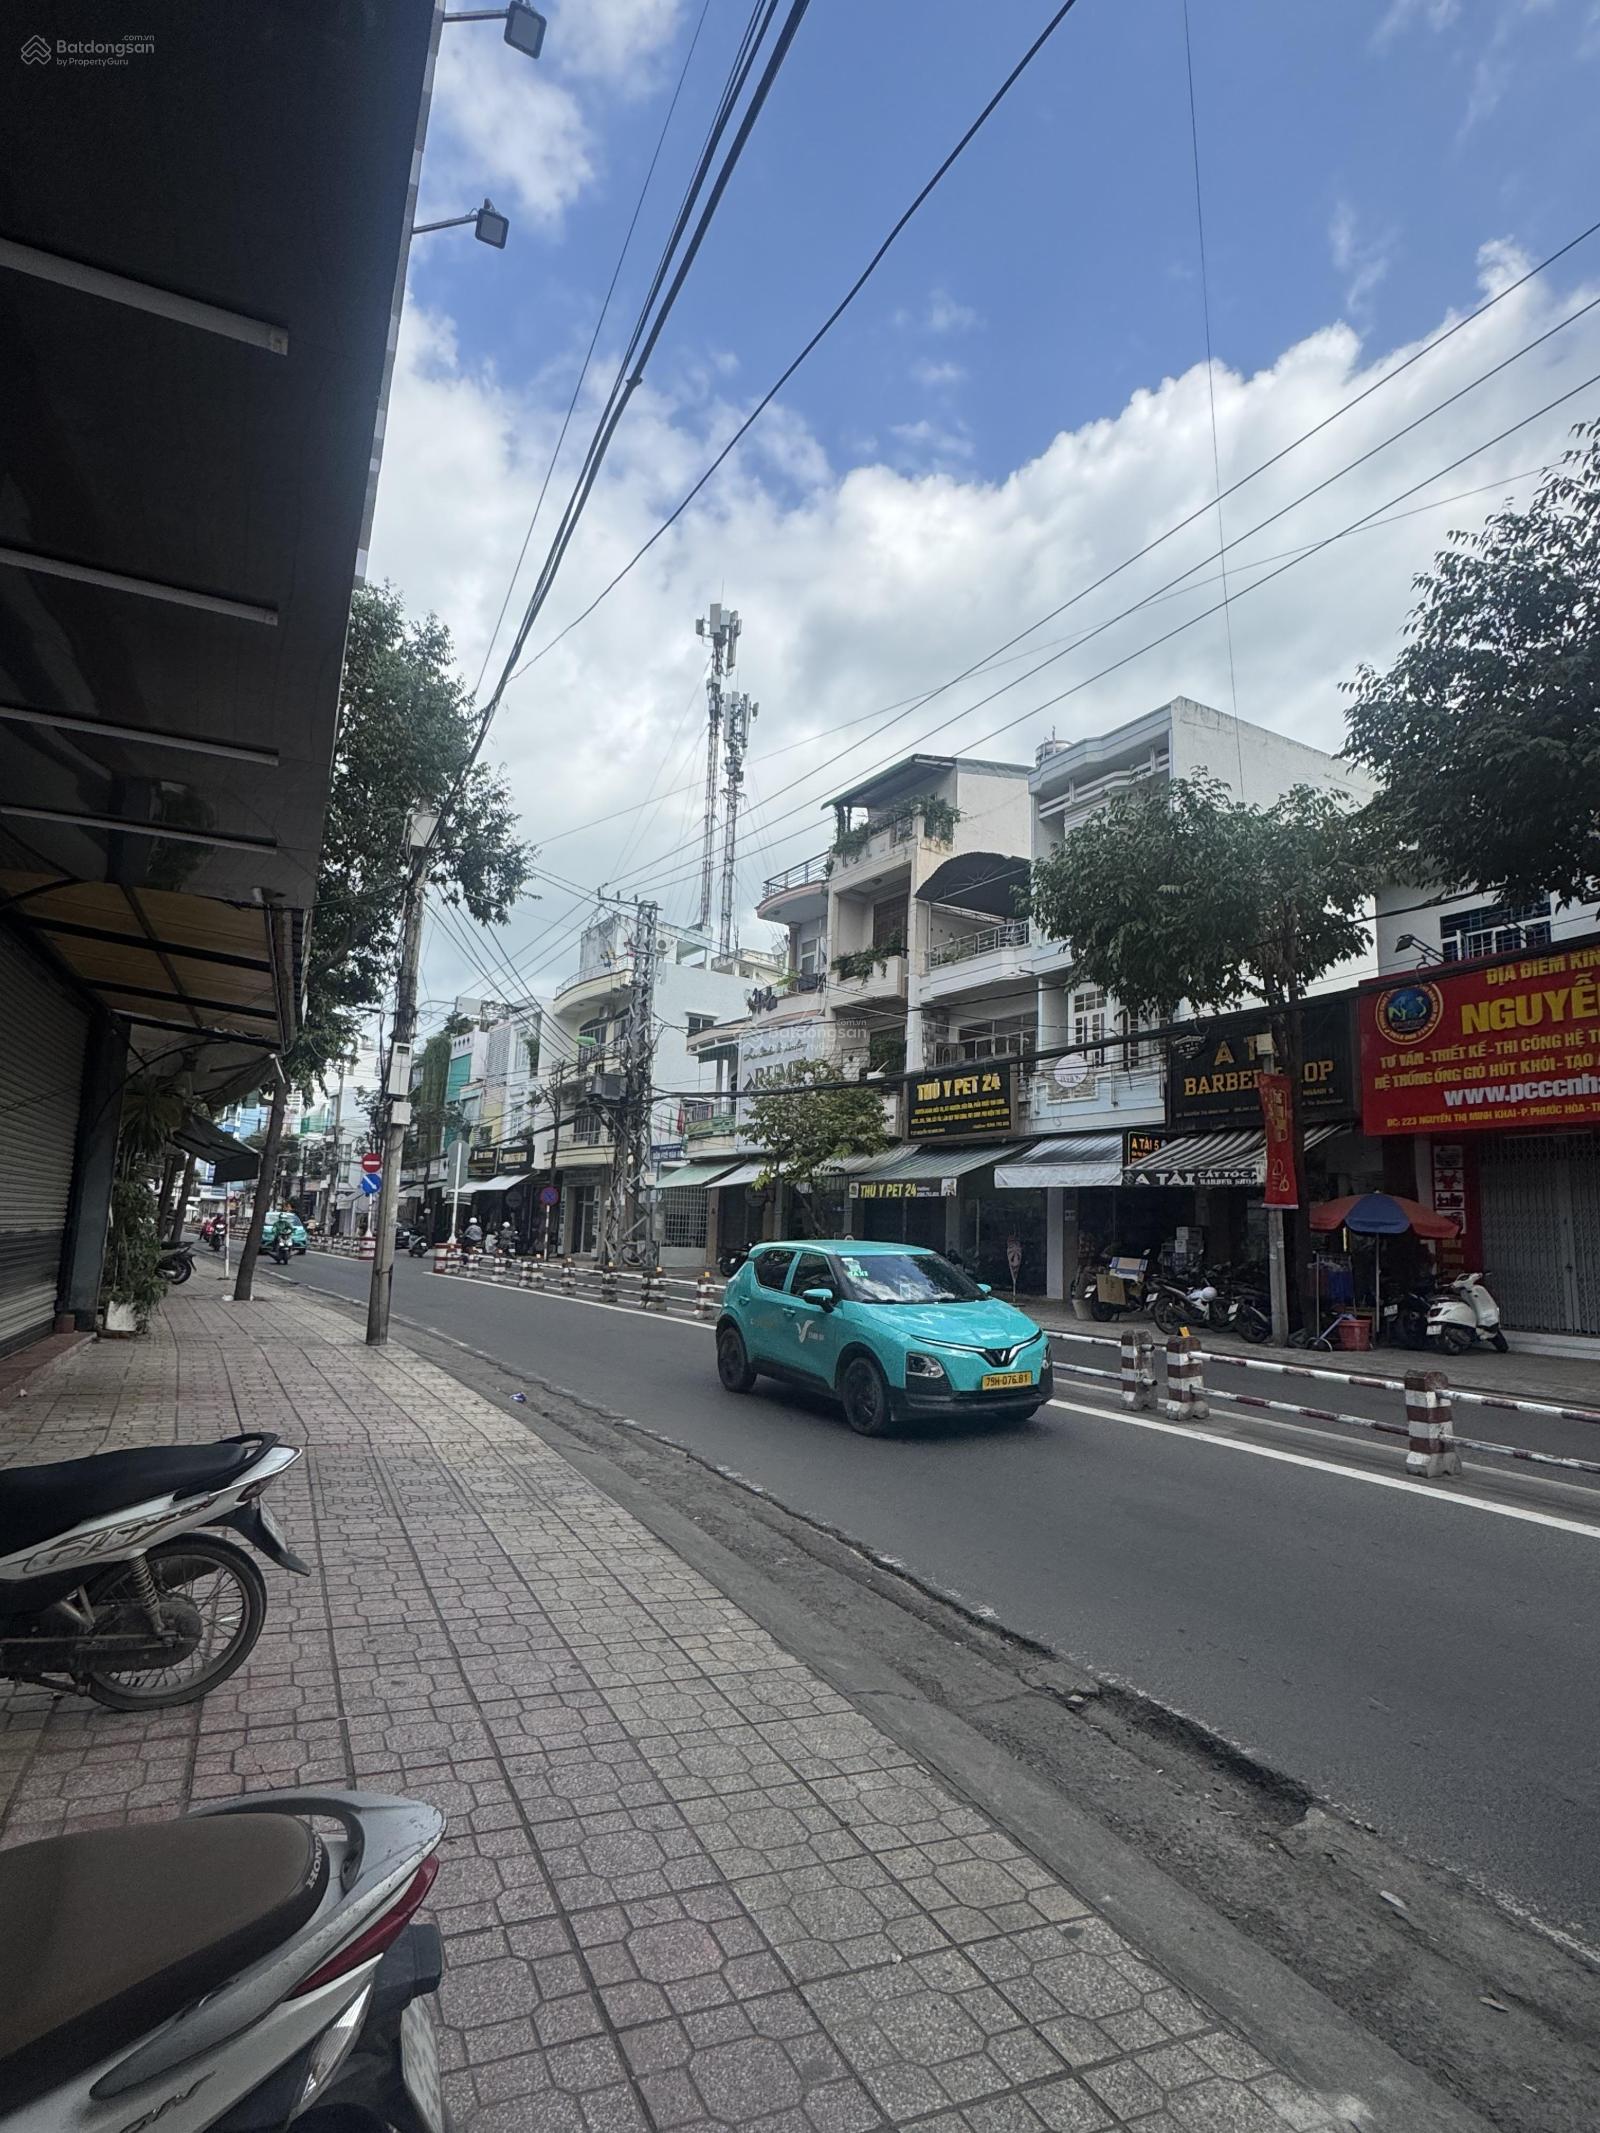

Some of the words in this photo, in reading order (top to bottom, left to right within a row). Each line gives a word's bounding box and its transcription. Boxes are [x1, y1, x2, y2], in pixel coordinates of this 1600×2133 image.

[1486, 964, 1516, 986] ĐỊA
[1461, 972, 1600, 1035] NGUYỄ
[1214, 1040, 1234, 1066] A
[1380, 1054, 1397, 1069] TƯ
[1431, 1044, 1466, 1063] THIẾT
[1468, 1040, 1487, 1058] KẾ
[1495, 1040, 1518, 1055] THI
[1521, 1034, 1562, 1052] CÔNG
[1564, 1028, 1585, 1048] HỆ
[1374, 1074, 1391, 1091] HỆ
[1392, 1070, 1433, 1088] THỐNG
[1434, 1066, 1461, 1083] ỐNG
[1464, 1062, 1486, 1080] GIÓ
[1490, 1060, 1517, 1077] HÚT
[1521, 1055, 1556, 1074] KHÓI
[1564, 1053, 1594, 1071] TẠO
[943, 1080, 952, 1098] Y
[954, 1076, 979, 1096] PET
[982, 1073, 1001, 1092] 24
[1443, 1073, 1600, 1107] www.pcccnh
[1402, 1116, 1417, 1126] 223
[1494, 1108, 1516, 1119] KHAI
[1131, 1137, 1138, 1150] A
[1139, 1136, 1152, 1150] TÀI
[1154, 1140, 1160, 1152] 5
[879, 1184, 885, 1198] Y
[886, 1184, 904, 1198] PET
[905, 1183, 917, 1198] 24
[1135, 1174, 1150, 1186] A
[1156, 1170, 1195, 1186] TÀI
